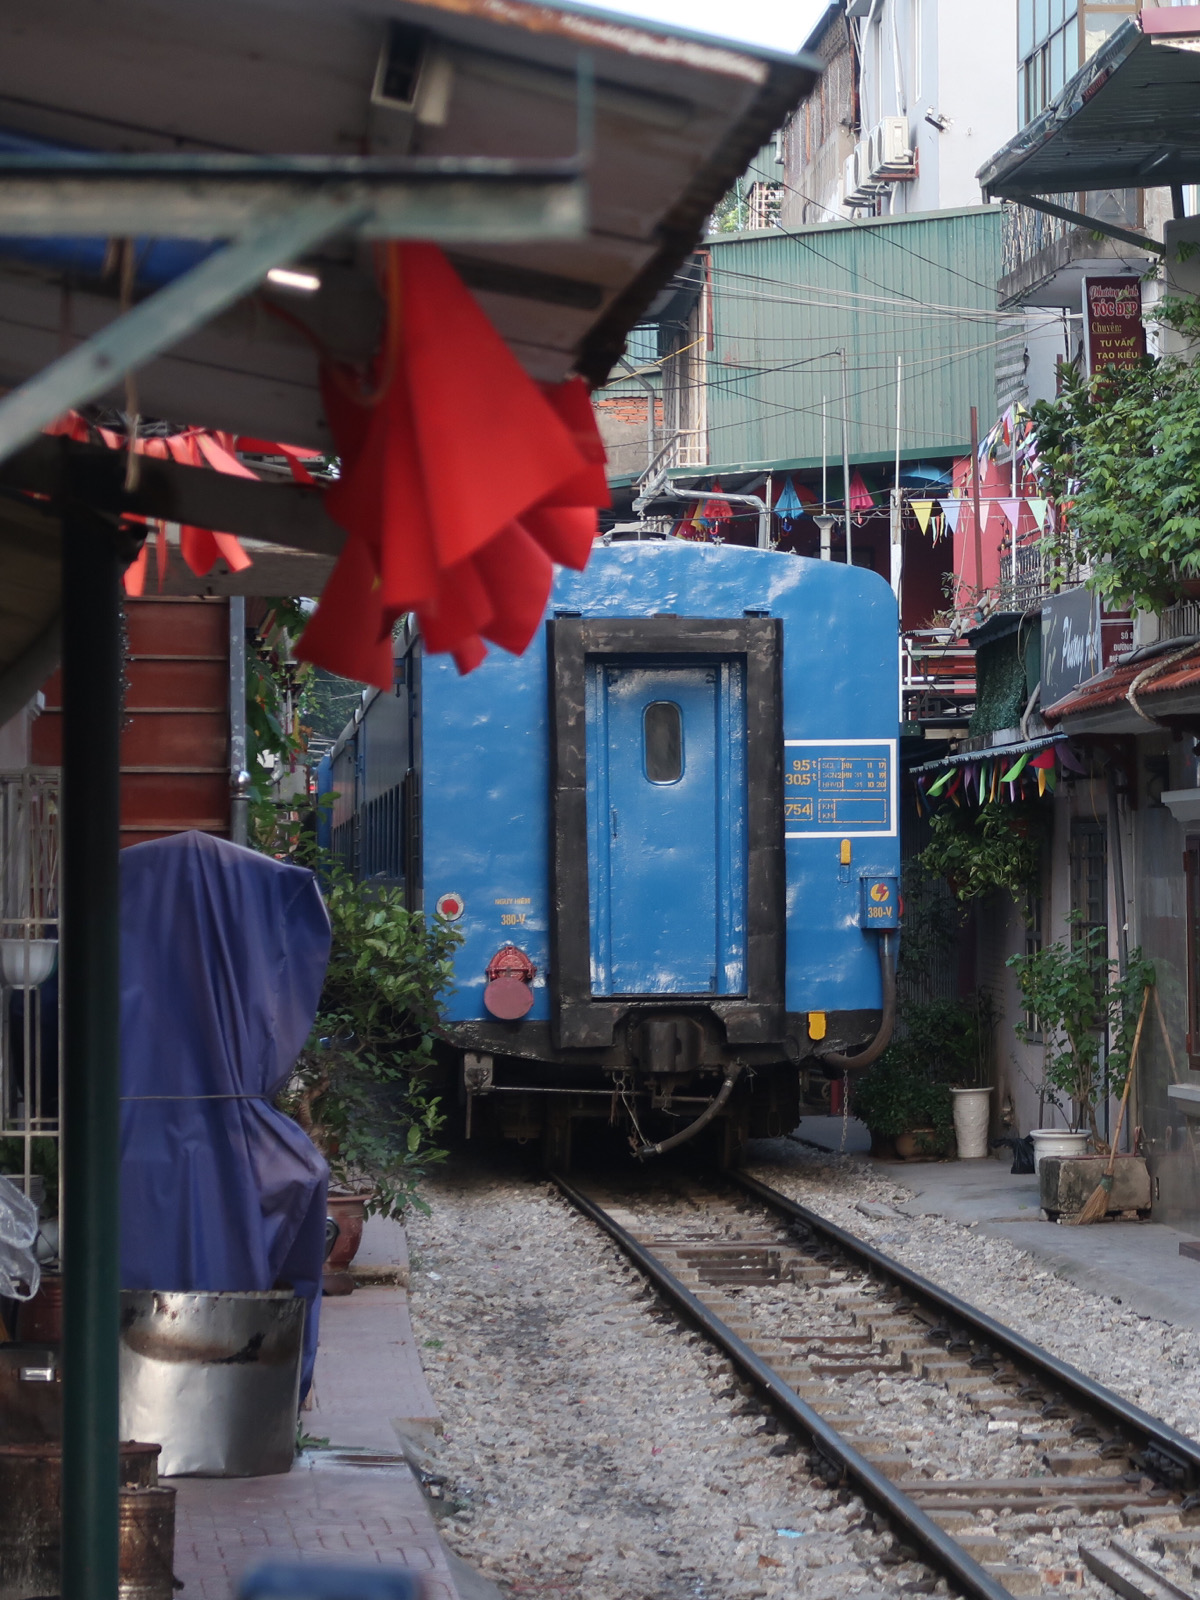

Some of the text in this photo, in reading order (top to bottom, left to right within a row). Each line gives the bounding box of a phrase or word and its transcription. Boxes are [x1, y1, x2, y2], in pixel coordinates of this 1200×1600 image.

[1092, 298, 1114, 317] TÓC
[1096, 352, 1115, 361] TẠO
[868, 906, 892, 918] 380-V
[501, 913, 526, 925] 380-V
